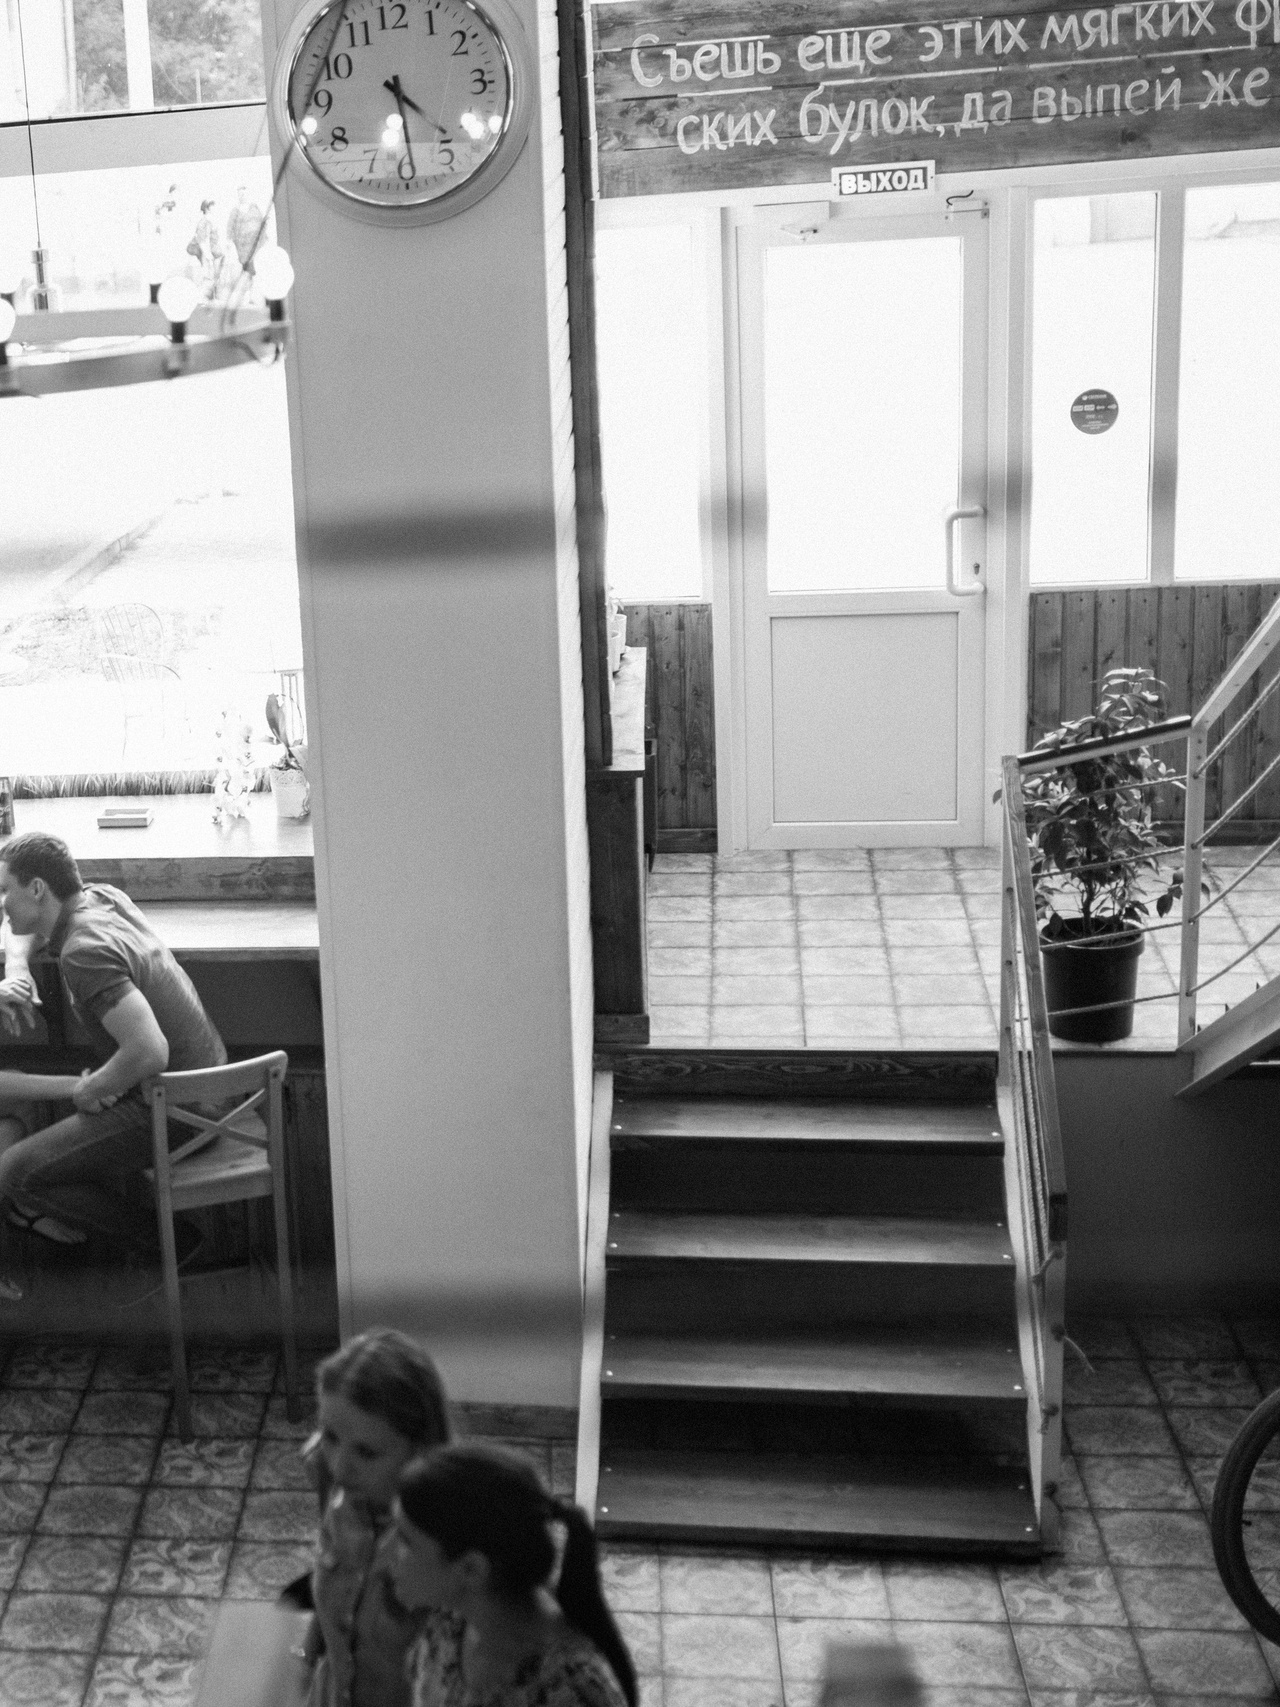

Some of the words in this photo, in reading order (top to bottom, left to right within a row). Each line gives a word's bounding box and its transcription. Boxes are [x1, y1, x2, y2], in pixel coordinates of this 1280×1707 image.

[376, 3, 409, 31] 12
[424, 9, 437, 36] 1
[346, 20, 373, 48] 11
[450, 29, 469, 56] 2
[631, 33, 781, 87] Съешь
[798, 29, 892, 74] еще
[918, 17, 1030, 62] этих
[1040, 1, 1217, 51] мягких
[324, 52, 353, 81] 10
[470, 68, 488, 95] 3
[313, 88, 333, 117] 9
[677, 109, 778, 154] ских
[954, 89, 1013, 137] да
[1032, 65, 1182, 124] выпей
[1199, 67, 1270, 110] же
[330, 126, 349, 152] 8
[437, 138, 454, 166] 5
[363, 148, 379, 174] 7
[397, 152, 417, 181] 6
[841, 168, 925, 195] ВЫХОД
